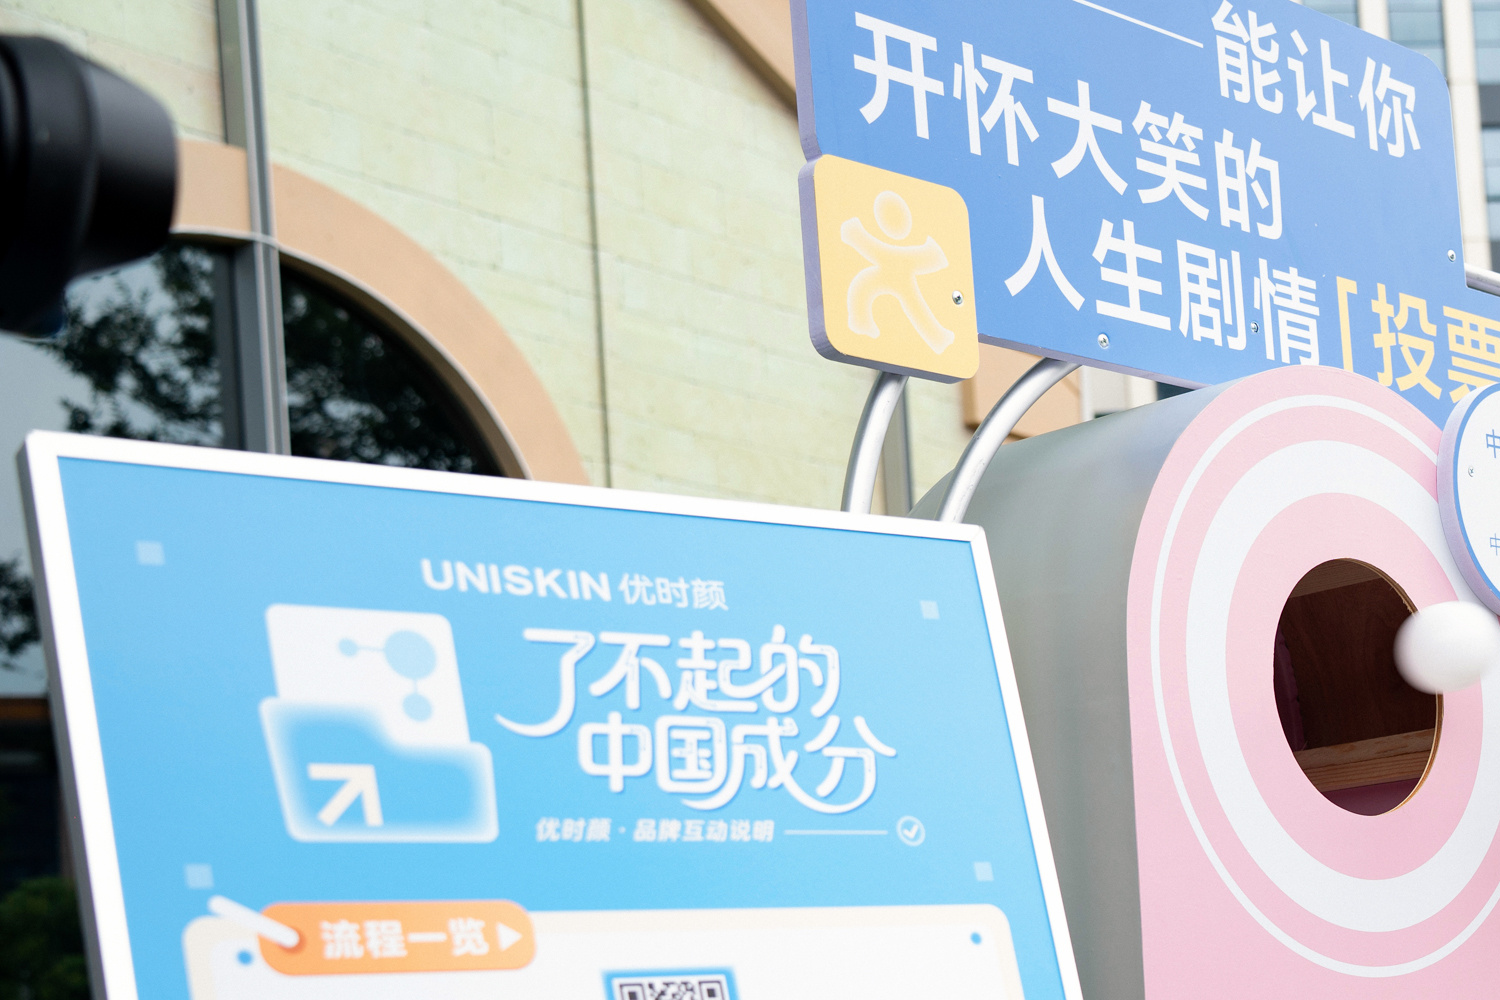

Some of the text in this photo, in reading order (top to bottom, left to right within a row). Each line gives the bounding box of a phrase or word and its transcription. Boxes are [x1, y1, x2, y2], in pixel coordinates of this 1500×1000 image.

[853, 11, 1284, 240] 开怀大笑的
[1210, 1, 1421, 158] 能让你
[420, 558, 729, 611] UNISKIN 优时颜
[494, 624, 842, 738] 了不起的
[577, 710, 898, 815] 中国成分
[320, 917, 490, 960] 流程一览
